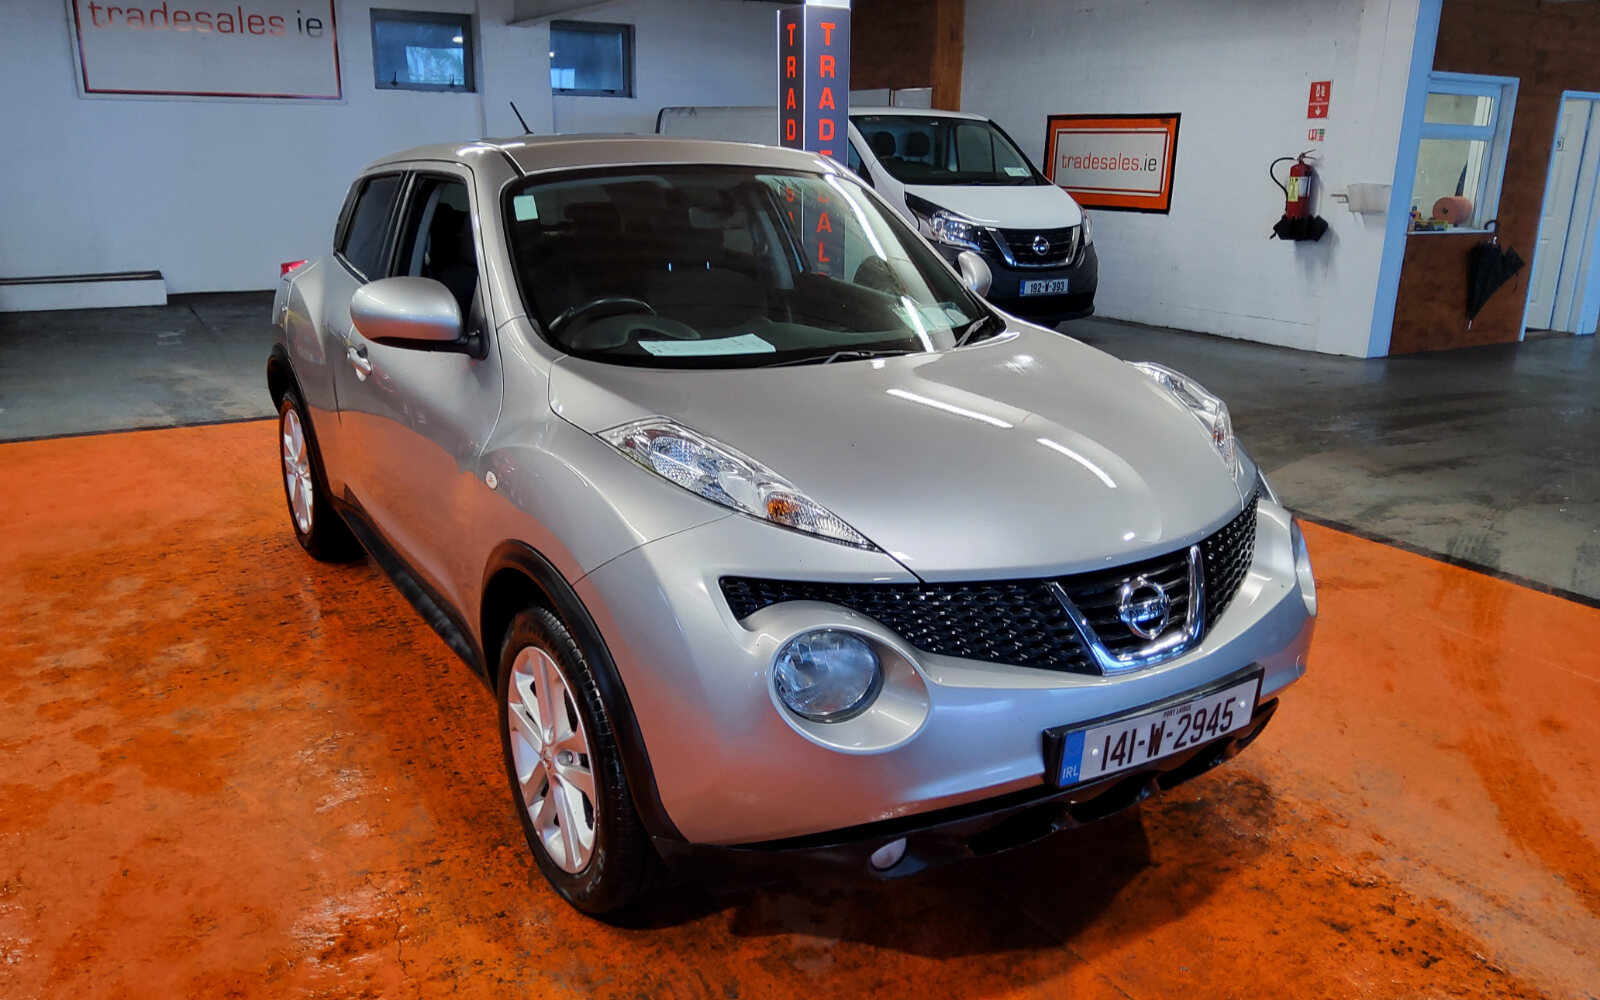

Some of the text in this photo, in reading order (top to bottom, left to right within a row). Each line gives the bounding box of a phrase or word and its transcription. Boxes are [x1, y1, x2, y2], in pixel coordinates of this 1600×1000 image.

[88, 2, 287, 36] tradesales
[786, 23, 796, 141] TRAD
[818, 22, 835, 155] TRAD
[1061, 152, 1157, 172] tradesales.ie
[1100, 697, 1236, 771] 141-W-2945
[1062, 765, 1079, 779] IRL
